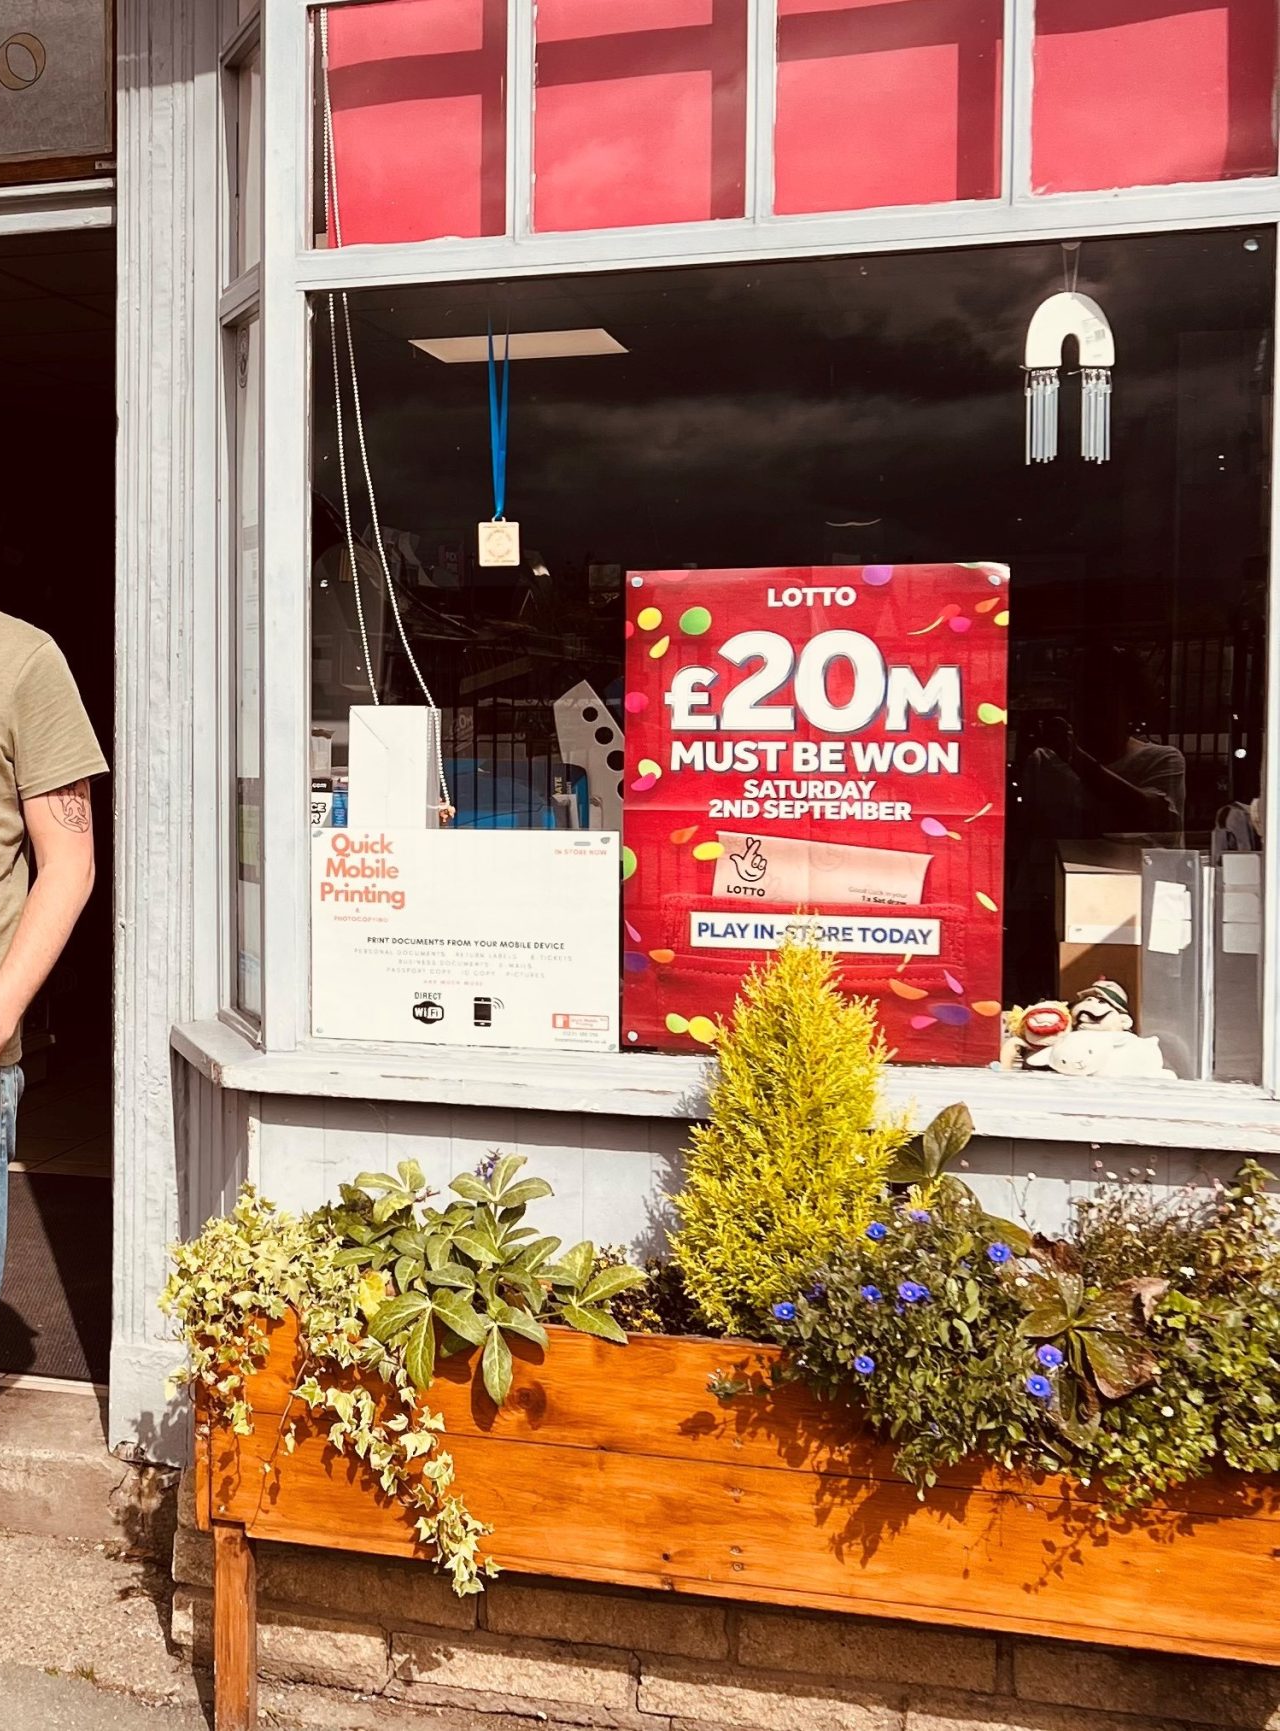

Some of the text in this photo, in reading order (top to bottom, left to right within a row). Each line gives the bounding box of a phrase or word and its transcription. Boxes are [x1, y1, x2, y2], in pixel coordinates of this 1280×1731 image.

[768, 586, 857, 607] LOTTO
[664, 629, 963, 733] £20M
[670, 741, 960, 774] MUST BE WON
[743, 779, 877, 800] SATURDAY
[708, 799, 913, 821] 2ND SEPTEMBER
[331, 833, 394, 858] Quick
[326, 857, 399, 879] Mobile
[320, 881, 405, 910] Printing
[727, 885, 766, 897] LOTTO
[367, 936, 565, 950] PRINT DOCUMENTS FROM YOUR MOBILE DEVICE
[698, 922, 750, 939] PLAY
[856, 927, 933, 945] TODAY
[414, 991, 442, 1000] DIRECT
